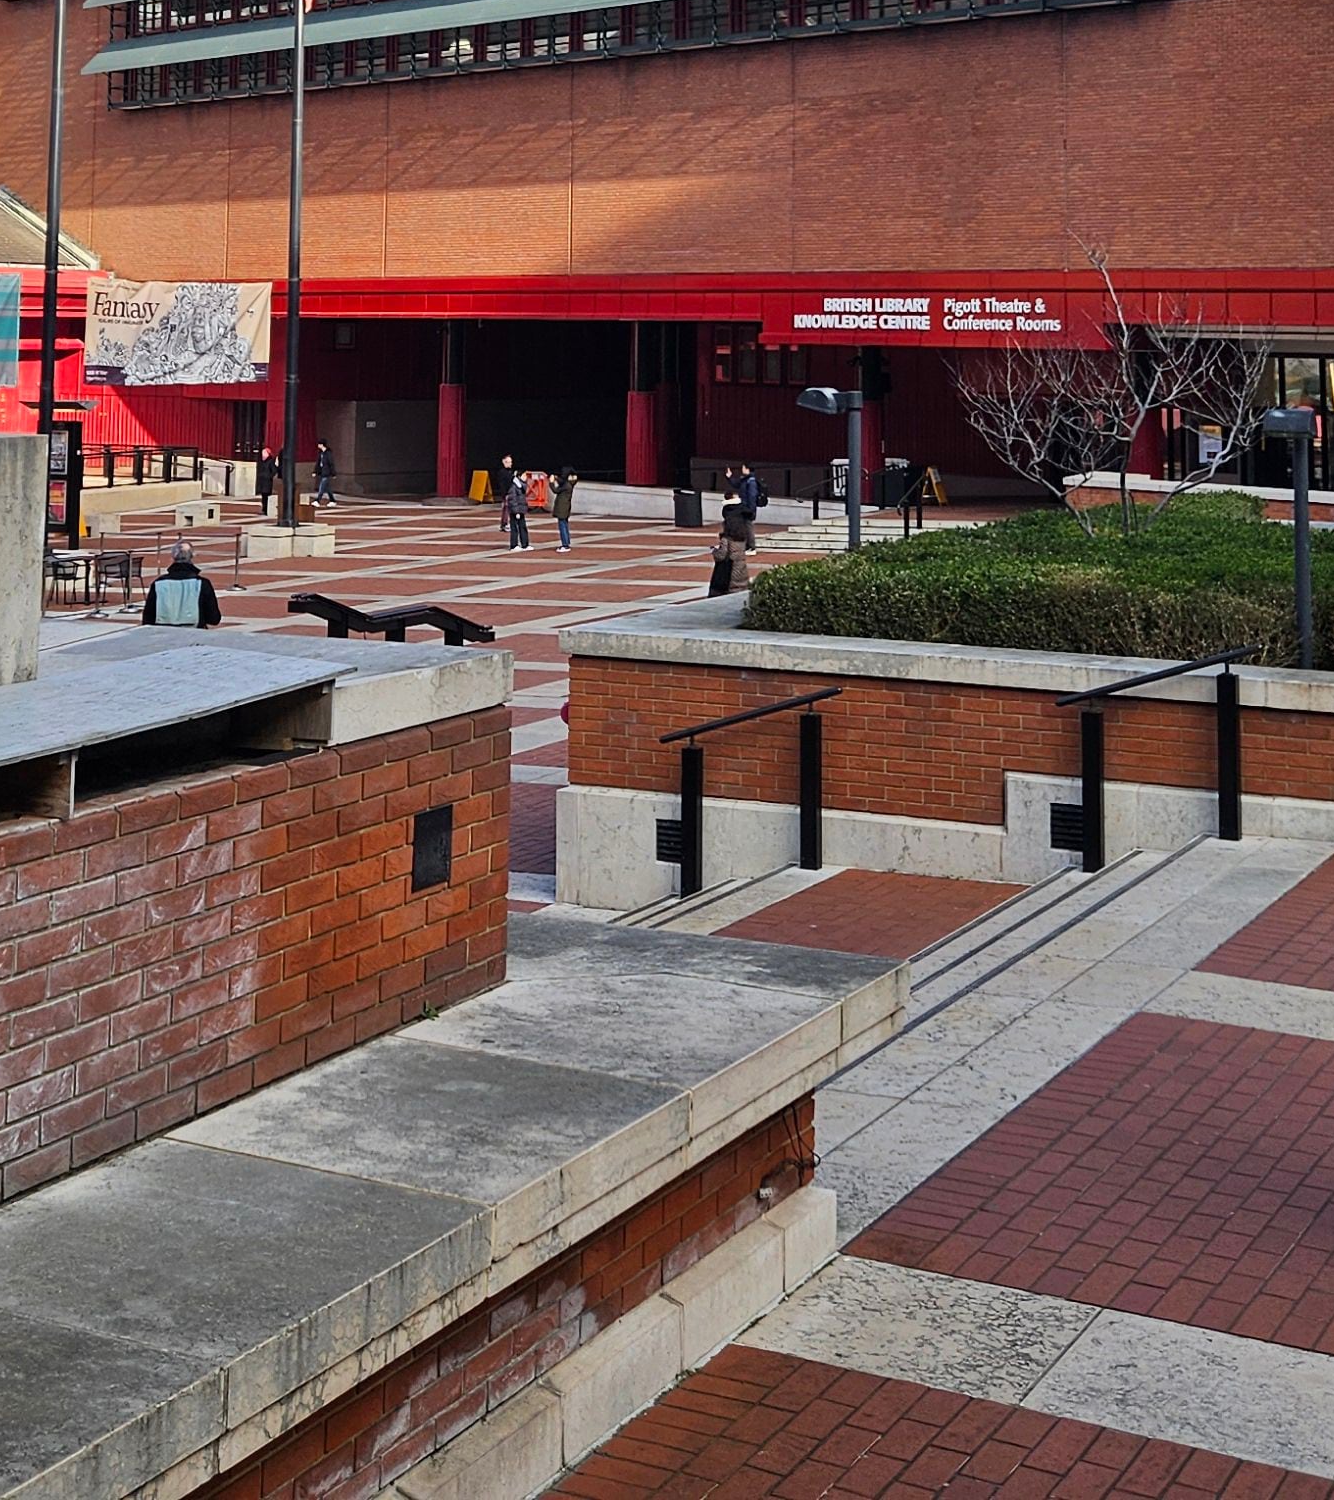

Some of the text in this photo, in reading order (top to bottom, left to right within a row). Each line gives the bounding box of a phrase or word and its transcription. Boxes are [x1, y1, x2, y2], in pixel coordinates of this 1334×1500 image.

[93, 291, 160, 324] Fantasy
[824, 298, 930, 312] BRITISH LIBRARY
[943, 297, 1046, 317] Pigott Theatre &
[794, 315, 930, 330] KNOWLEDGE CENTRE
[943, 315, 1061, 331] Conference Rooms
